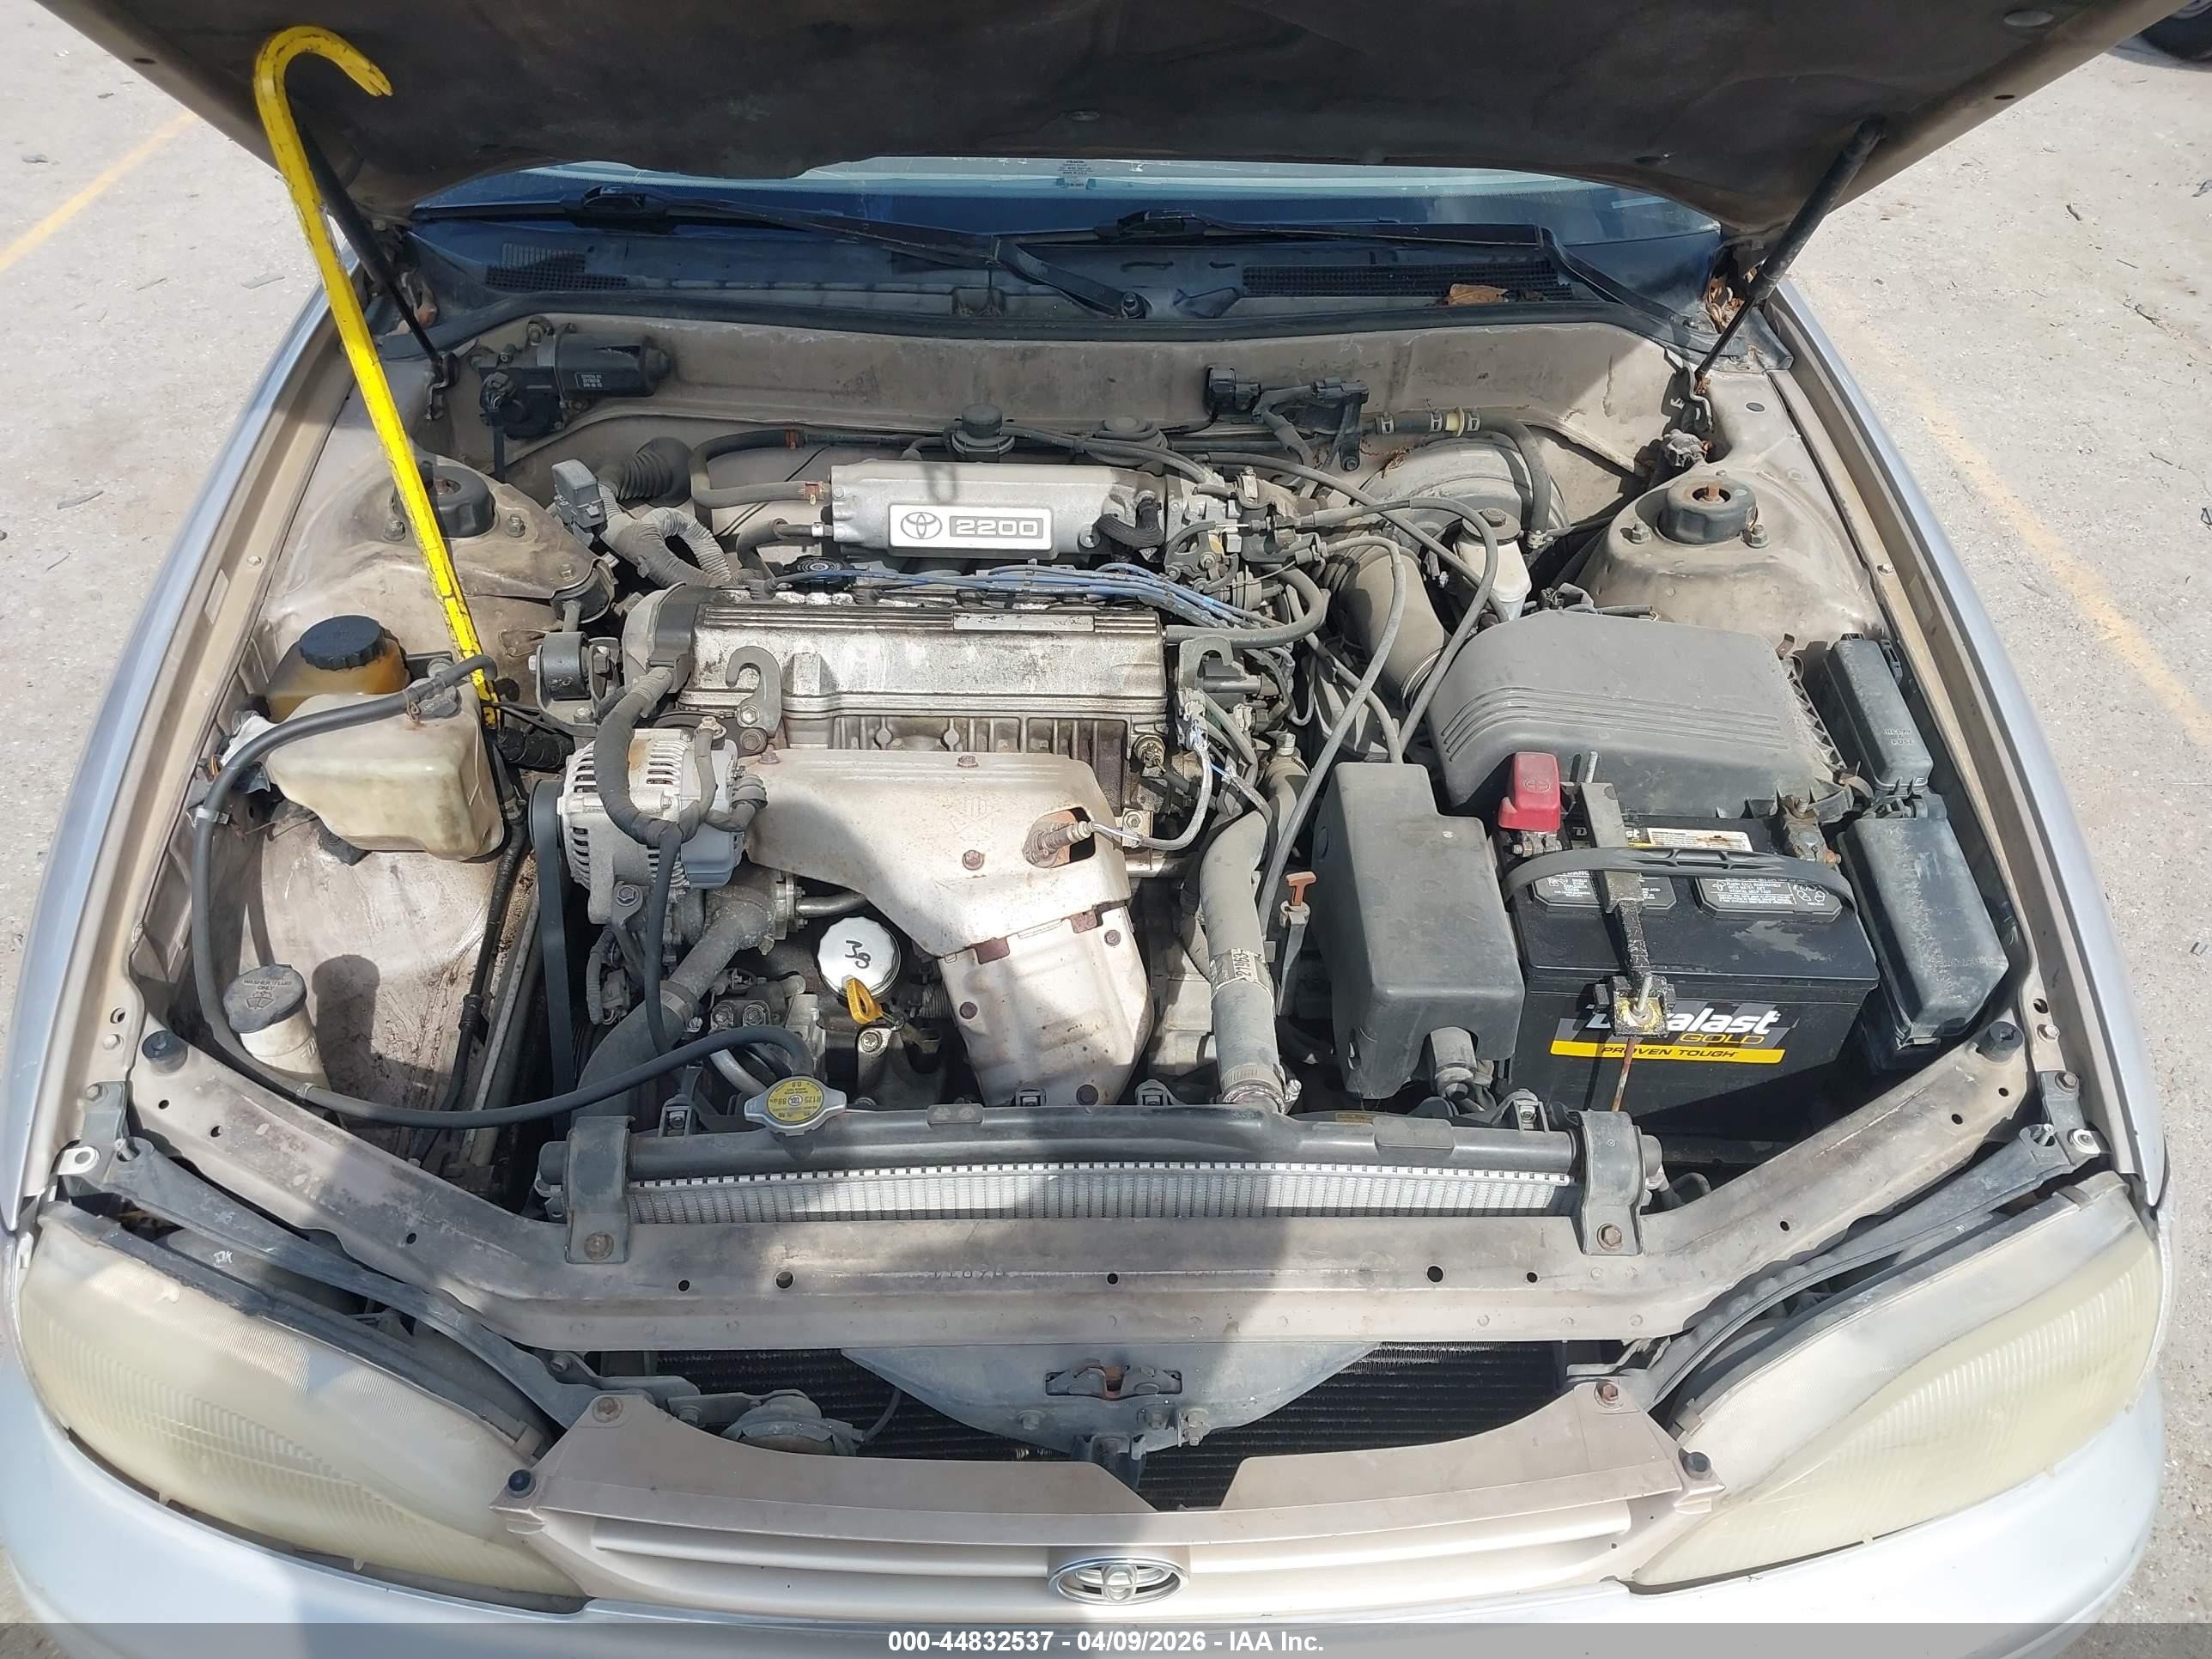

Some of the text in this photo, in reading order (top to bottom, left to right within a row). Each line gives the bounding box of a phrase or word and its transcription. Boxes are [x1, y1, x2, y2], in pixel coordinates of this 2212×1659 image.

[956, 519, 1038, 537] 2200
[1585, 1005, 1782, 1035] alast
[1680, 1033, 1765, 1045] GOLD
[1678, 1049, 1736, 1058] TOUGH
